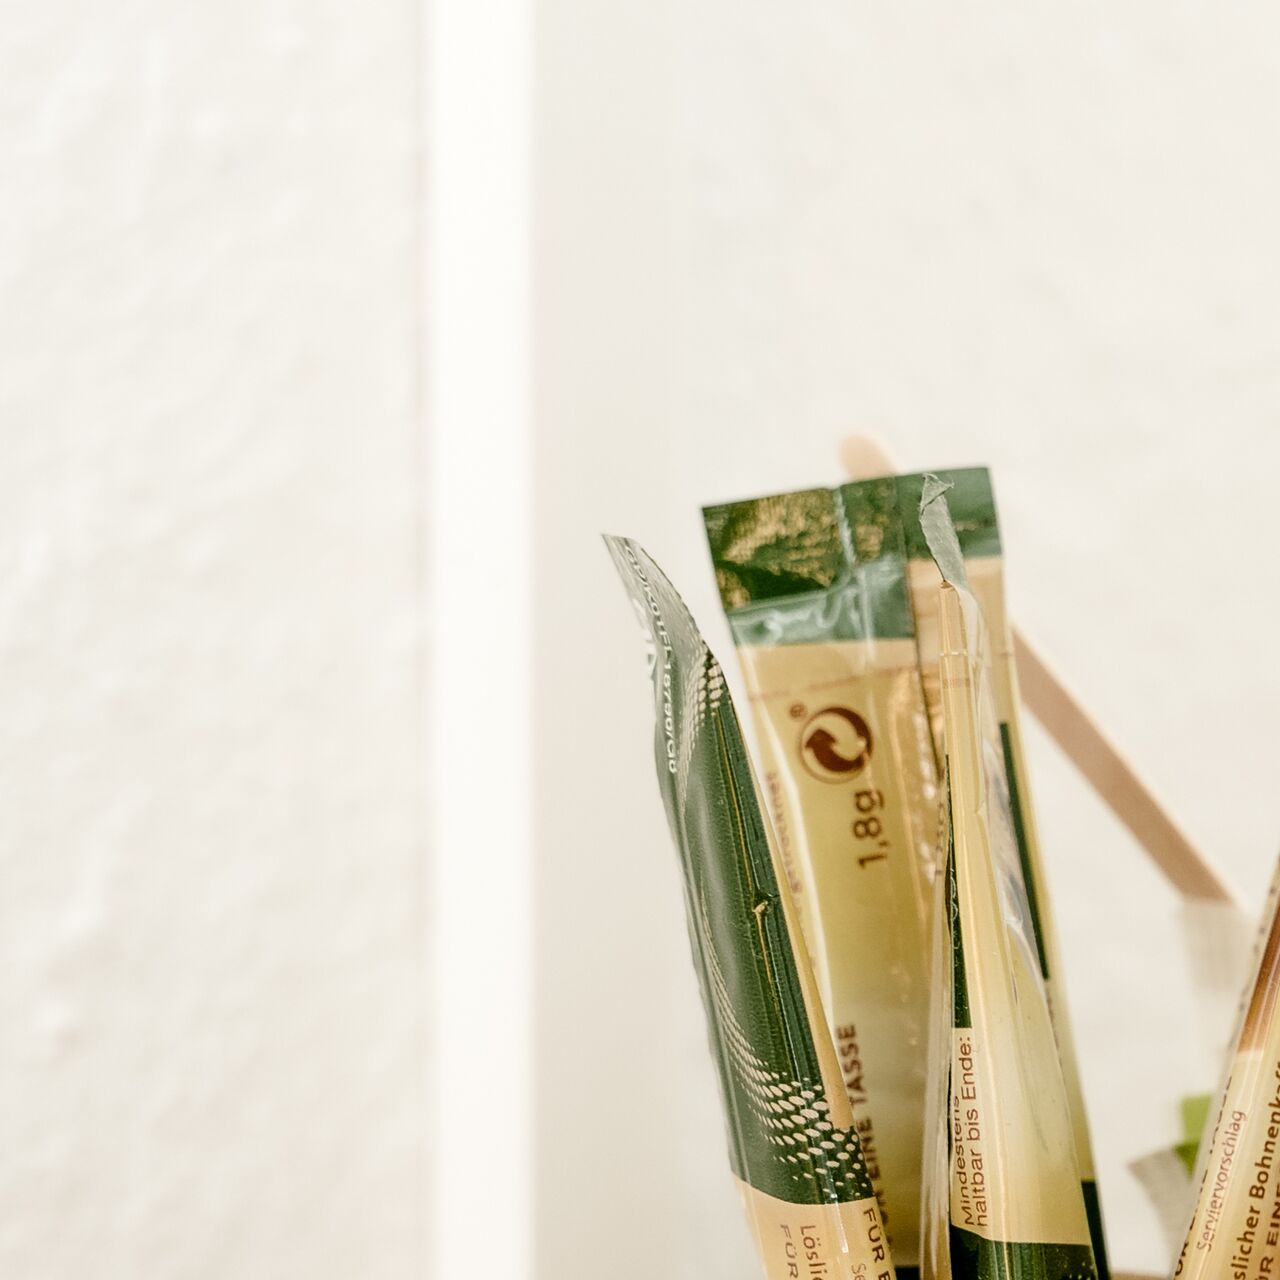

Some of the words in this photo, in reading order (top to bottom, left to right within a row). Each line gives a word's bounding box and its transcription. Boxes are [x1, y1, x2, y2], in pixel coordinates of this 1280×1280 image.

[853, 790, 889, 869] 1,8g
[837, 1024, 866, 1109] TASSE
[958, 1036, 977, 1100] Ende:
[965, 1108, 981, 1142] bis
[970, 1151, 990, 1227] haltbar
[1197, 1110, 1246, 1252] Serviervorschlag
[780, 1224, 799, 1279] FÜR
[863, 1207, 886, 1263] FÜR
